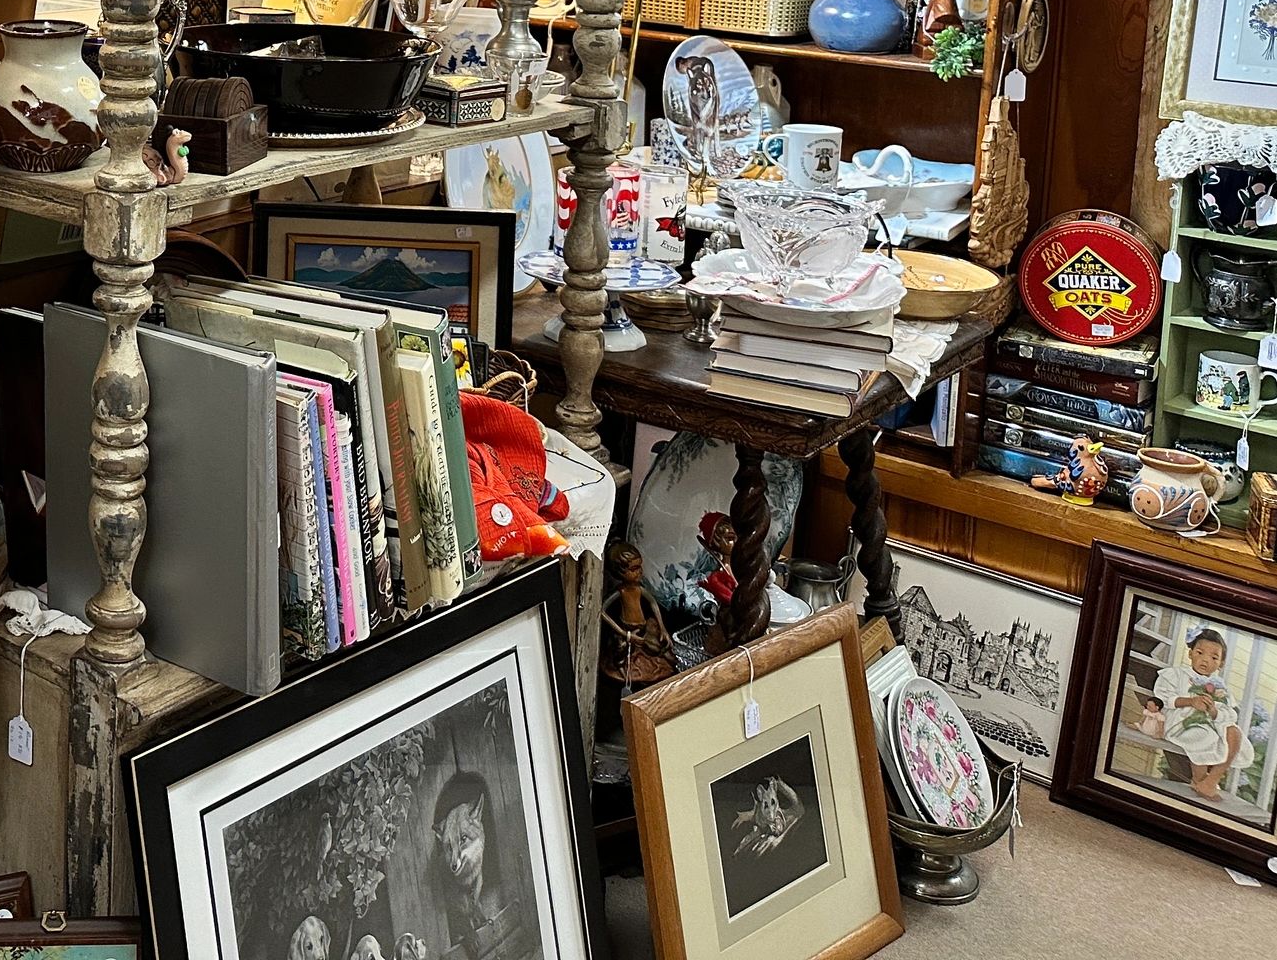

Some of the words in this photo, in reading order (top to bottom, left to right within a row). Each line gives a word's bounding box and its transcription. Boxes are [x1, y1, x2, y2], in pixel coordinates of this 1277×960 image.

[1074, 262, 1103, 271] PURE
[1064, 292, 1113, 304] OATS
[428, 374, 438, 415] Guide
[1033, 367, 1067, 386] SHADOW
[1068, 376, 1098, 393] THIEVES
[327, 398, 336, 429] TRACY
[1027, 389, 1058, 405] CROWN
[1064, 397, 1095, 413] THREE
[387, 401, 402, 444] PHOTO
[432, 419, 439, 430] to
[356, 443, 366, 483] BIRD
[435, 432, 448, 489] Creative
[392, 447, 413, 524] JOURNALISM
[359, 484, 374, 564] BEHAVIOR
